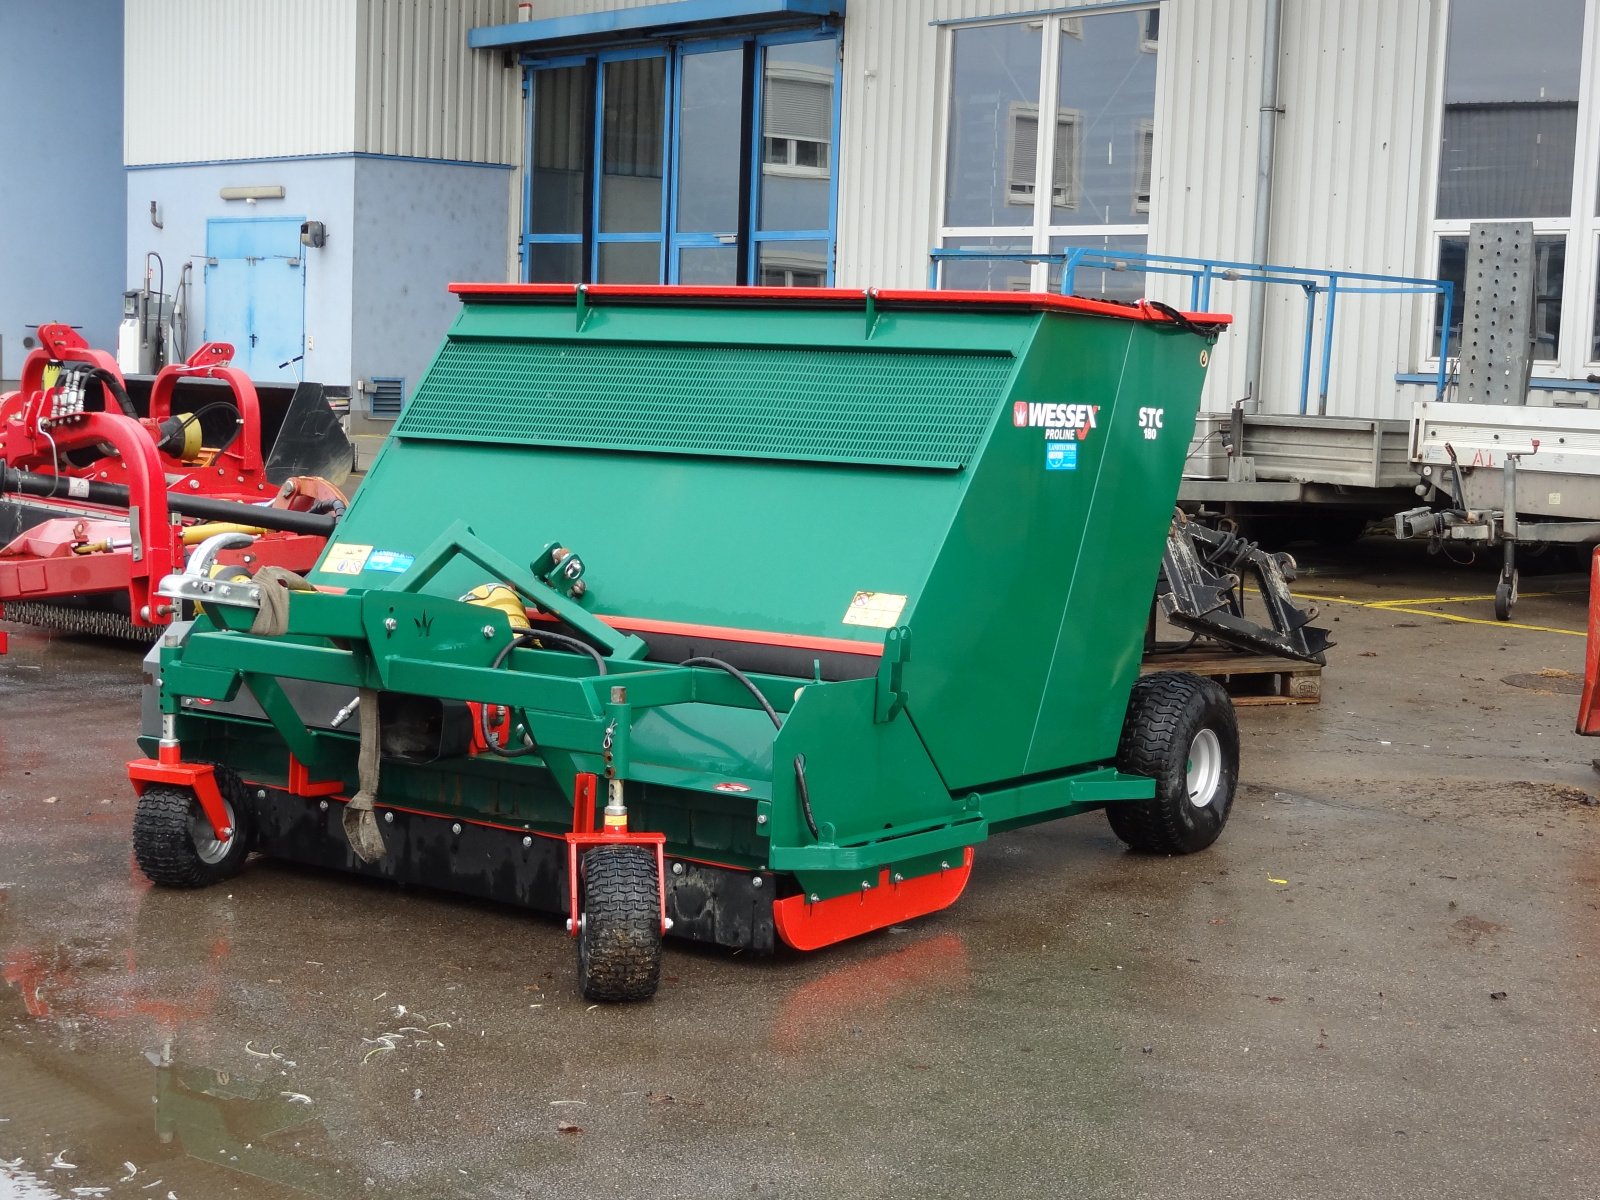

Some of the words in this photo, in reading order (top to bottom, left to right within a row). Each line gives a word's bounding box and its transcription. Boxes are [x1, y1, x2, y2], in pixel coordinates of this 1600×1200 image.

[1028, 402, 1098, 429] WESSEX
[1138, 406, 1164, 429] STC
[1045, 428, 1075, 440] PROLINE
[1143, 428, 1157, 440] 180
